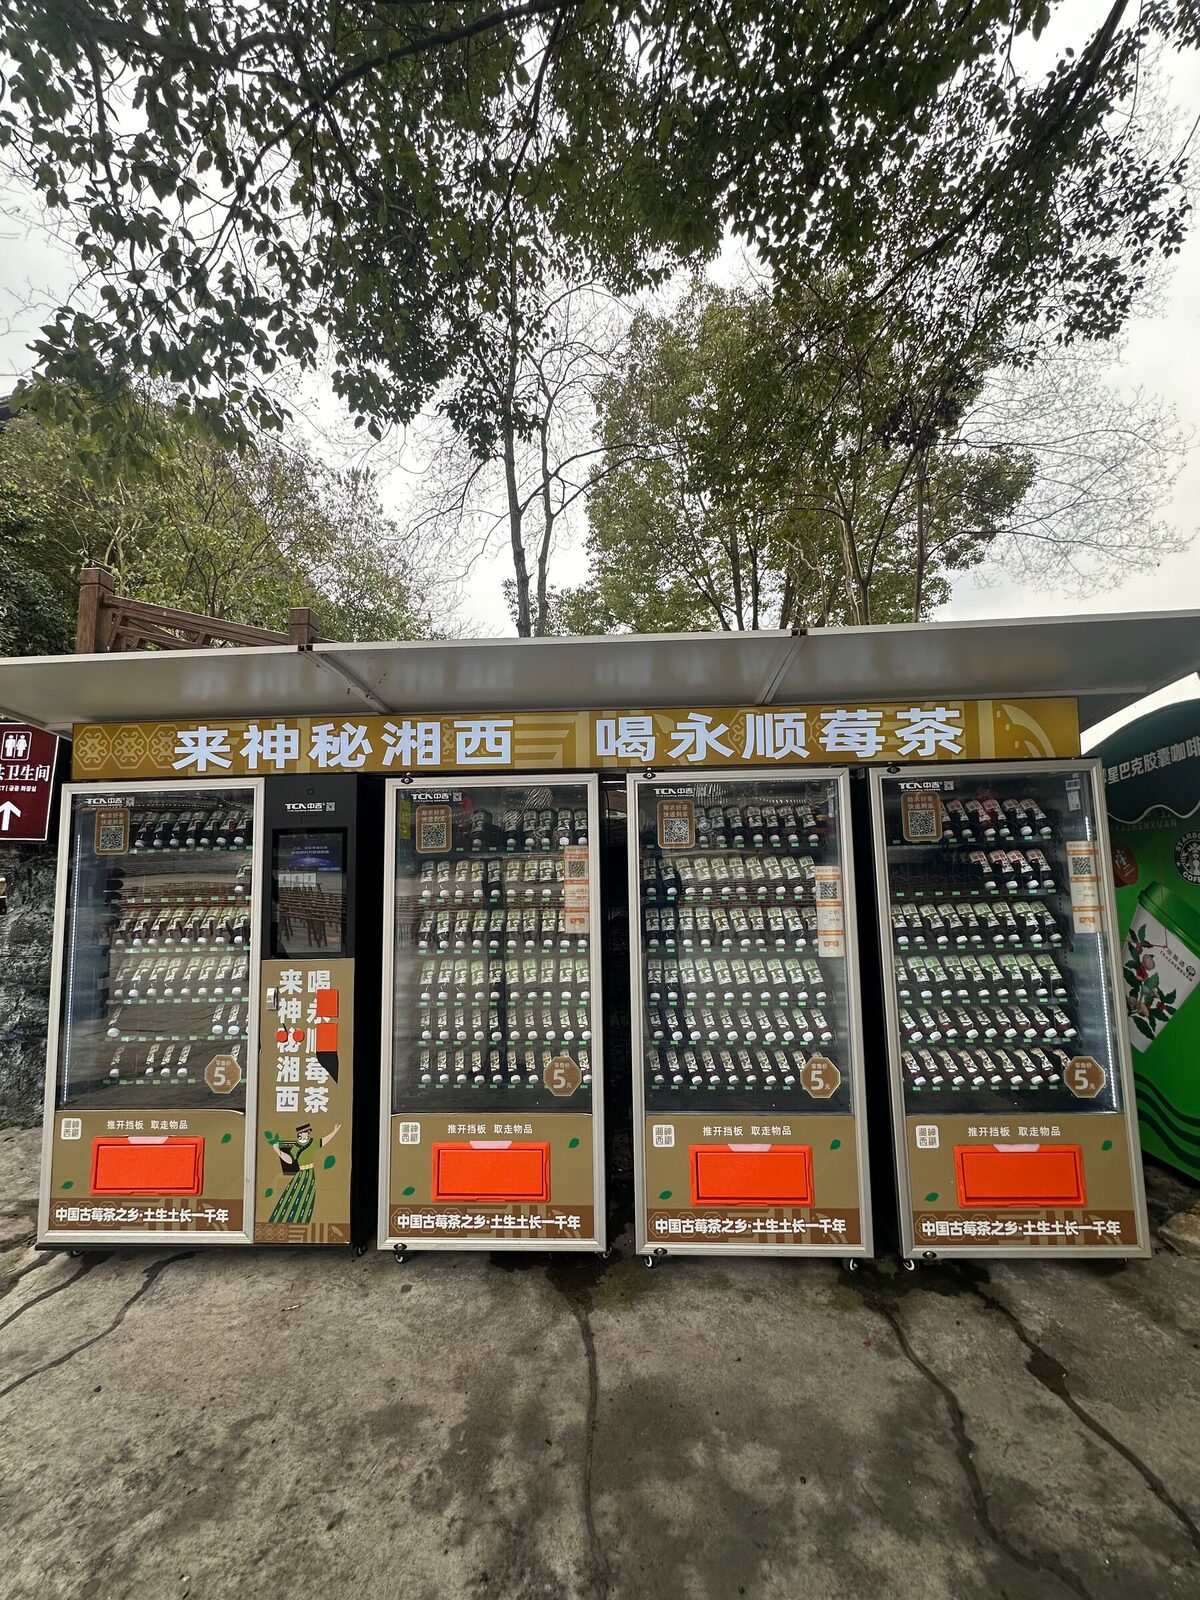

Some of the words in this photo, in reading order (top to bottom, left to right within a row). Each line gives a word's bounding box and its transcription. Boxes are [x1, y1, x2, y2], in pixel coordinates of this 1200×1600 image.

[171, 719, 514, 772] 来神秘湘西
[595, 706, 964, 762] 喝永顺莓茶
[275, 968, 304, 1113] 来神秘湘西
[106, 1120, 144, 1130] 推开挡板
[150, 1120, 188, 1130] 取走物品
[447, 1123, 487, 1134] 推开挡板
[493, 1123, 533, 1134] 取走物品
[702, 1125, 744, 1136] 推开挡板
[750, 1125, 792, 1136] 取走物品
[967, 1126, 1010, 1137] 推开挡板
[1018, 1126, 1061, 1137] 取走物品
